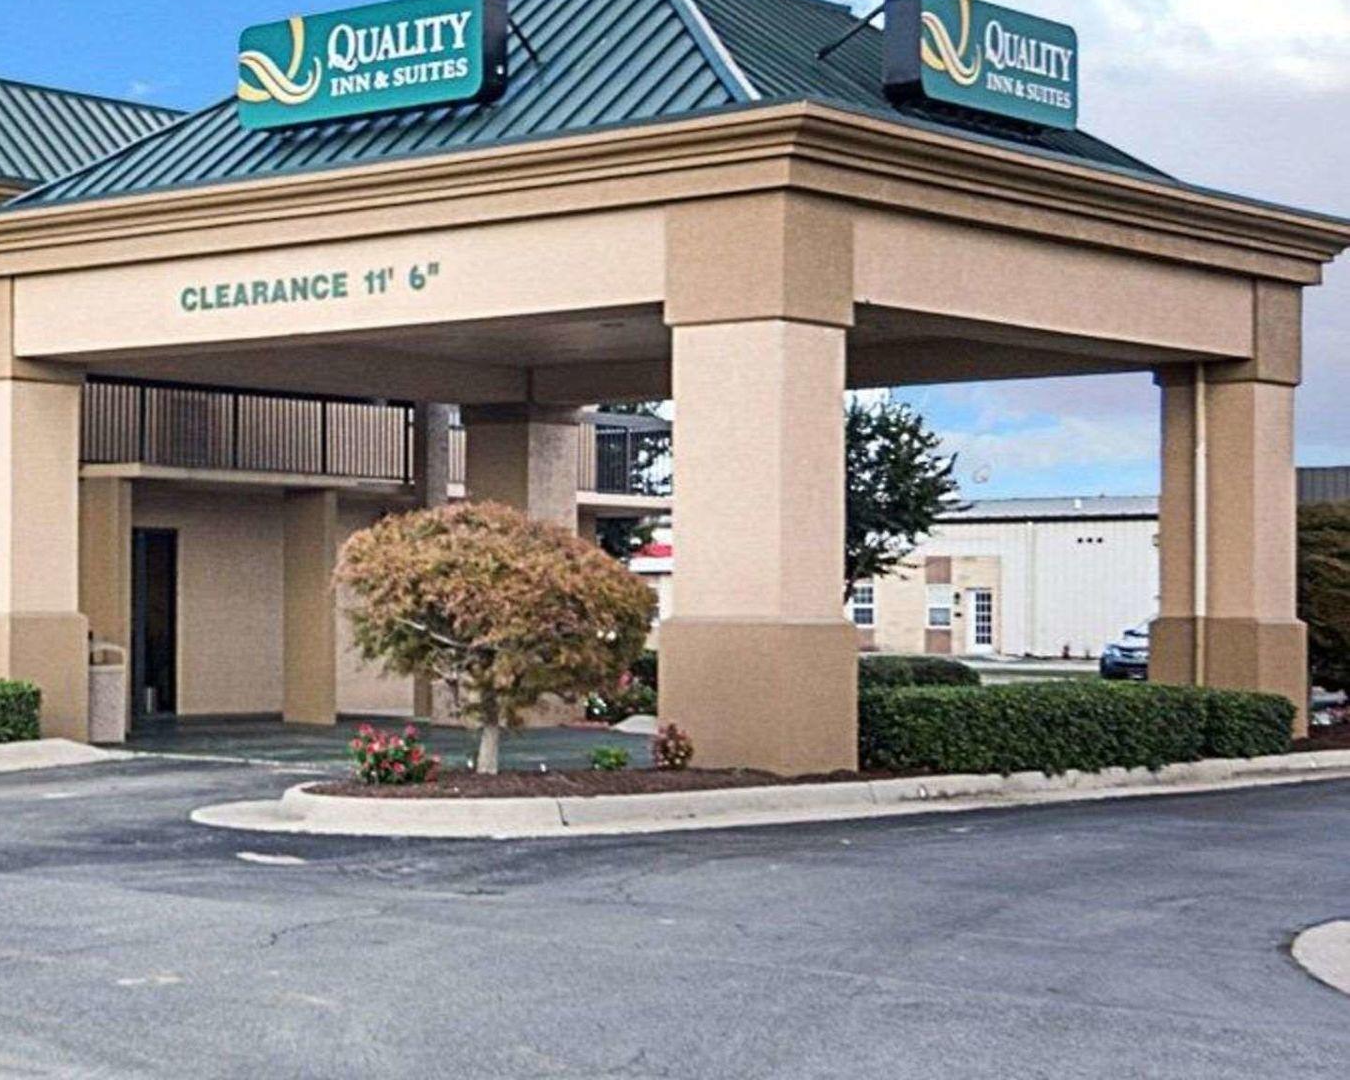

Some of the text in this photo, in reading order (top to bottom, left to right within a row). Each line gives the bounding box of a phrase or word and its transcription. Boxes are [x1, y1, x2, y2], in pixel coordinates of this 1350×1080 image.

[327, 11, 472, 71] QUALITY
[986, 21, 1072, 81] QUALITY
[330, 57, 468, 97] INN & SUITES
[987, 73, 1071, 108] INN & SUITES
[180, 272, 349, 312] CLEARANCE
[364, 267, 394, 295] 11'
